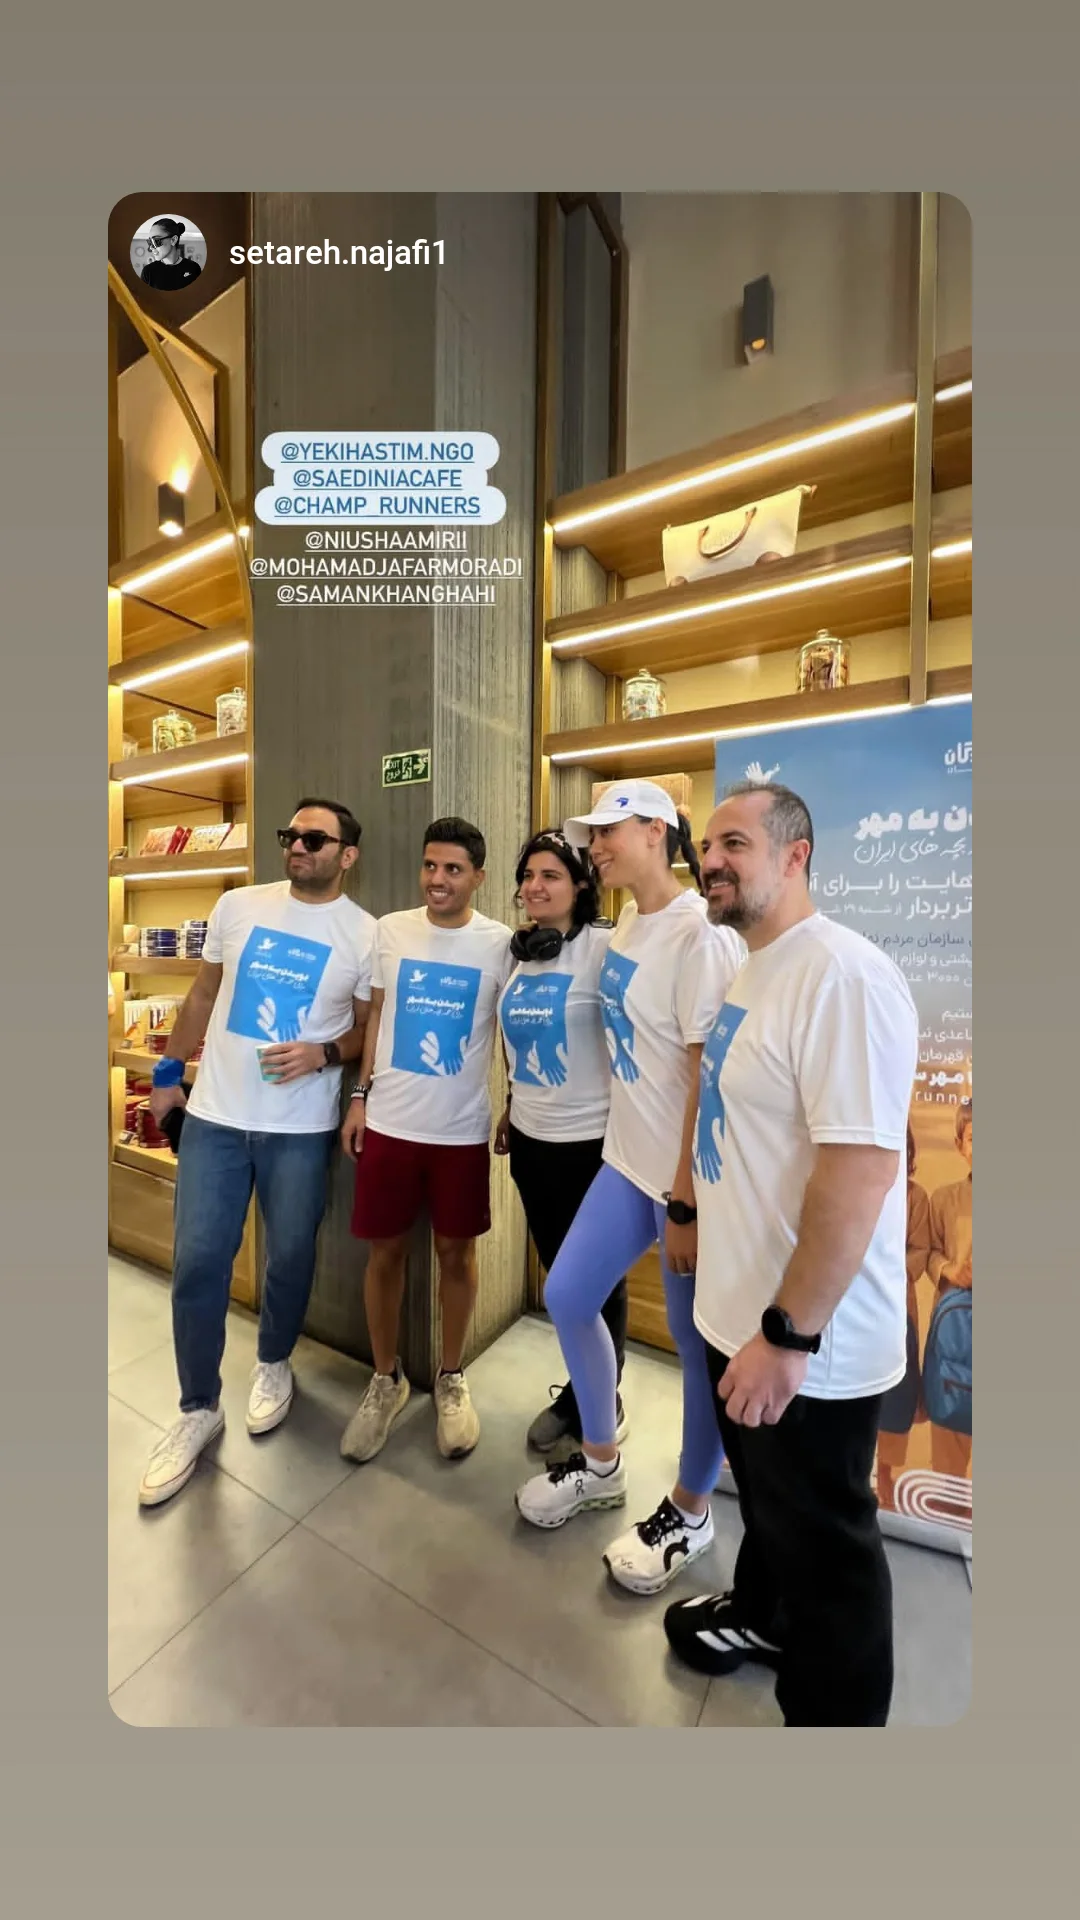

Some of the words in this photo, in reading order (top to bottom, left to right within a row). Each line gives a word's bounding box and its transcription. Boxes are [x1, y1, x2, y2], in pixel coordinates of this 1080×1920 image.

[854, 812, 903, 840] مهر
[908, 807, 939, 836] به
[853, 840, 896, 867] ایران
[899, 838, 939, 863] های
[823, 873, 883, 896] برای
[889, 872, 900, 895] را
[906, 896, 950, 920] بردار
[882, 933, 914, 947] مردم
[917, 930, 965, 948] سازمان
[900, 950, 927, 968] لوازم
[930, 956, 937, 967] و
[941, 1008, 972, 1024] ستیم
[934, 1028, 972, 1043] اعدی
[919, 1047, 964, 1064] قهرمان
[928, 1071, 965, 1086] مهر
[915, 1091, 970, 1105] runne
